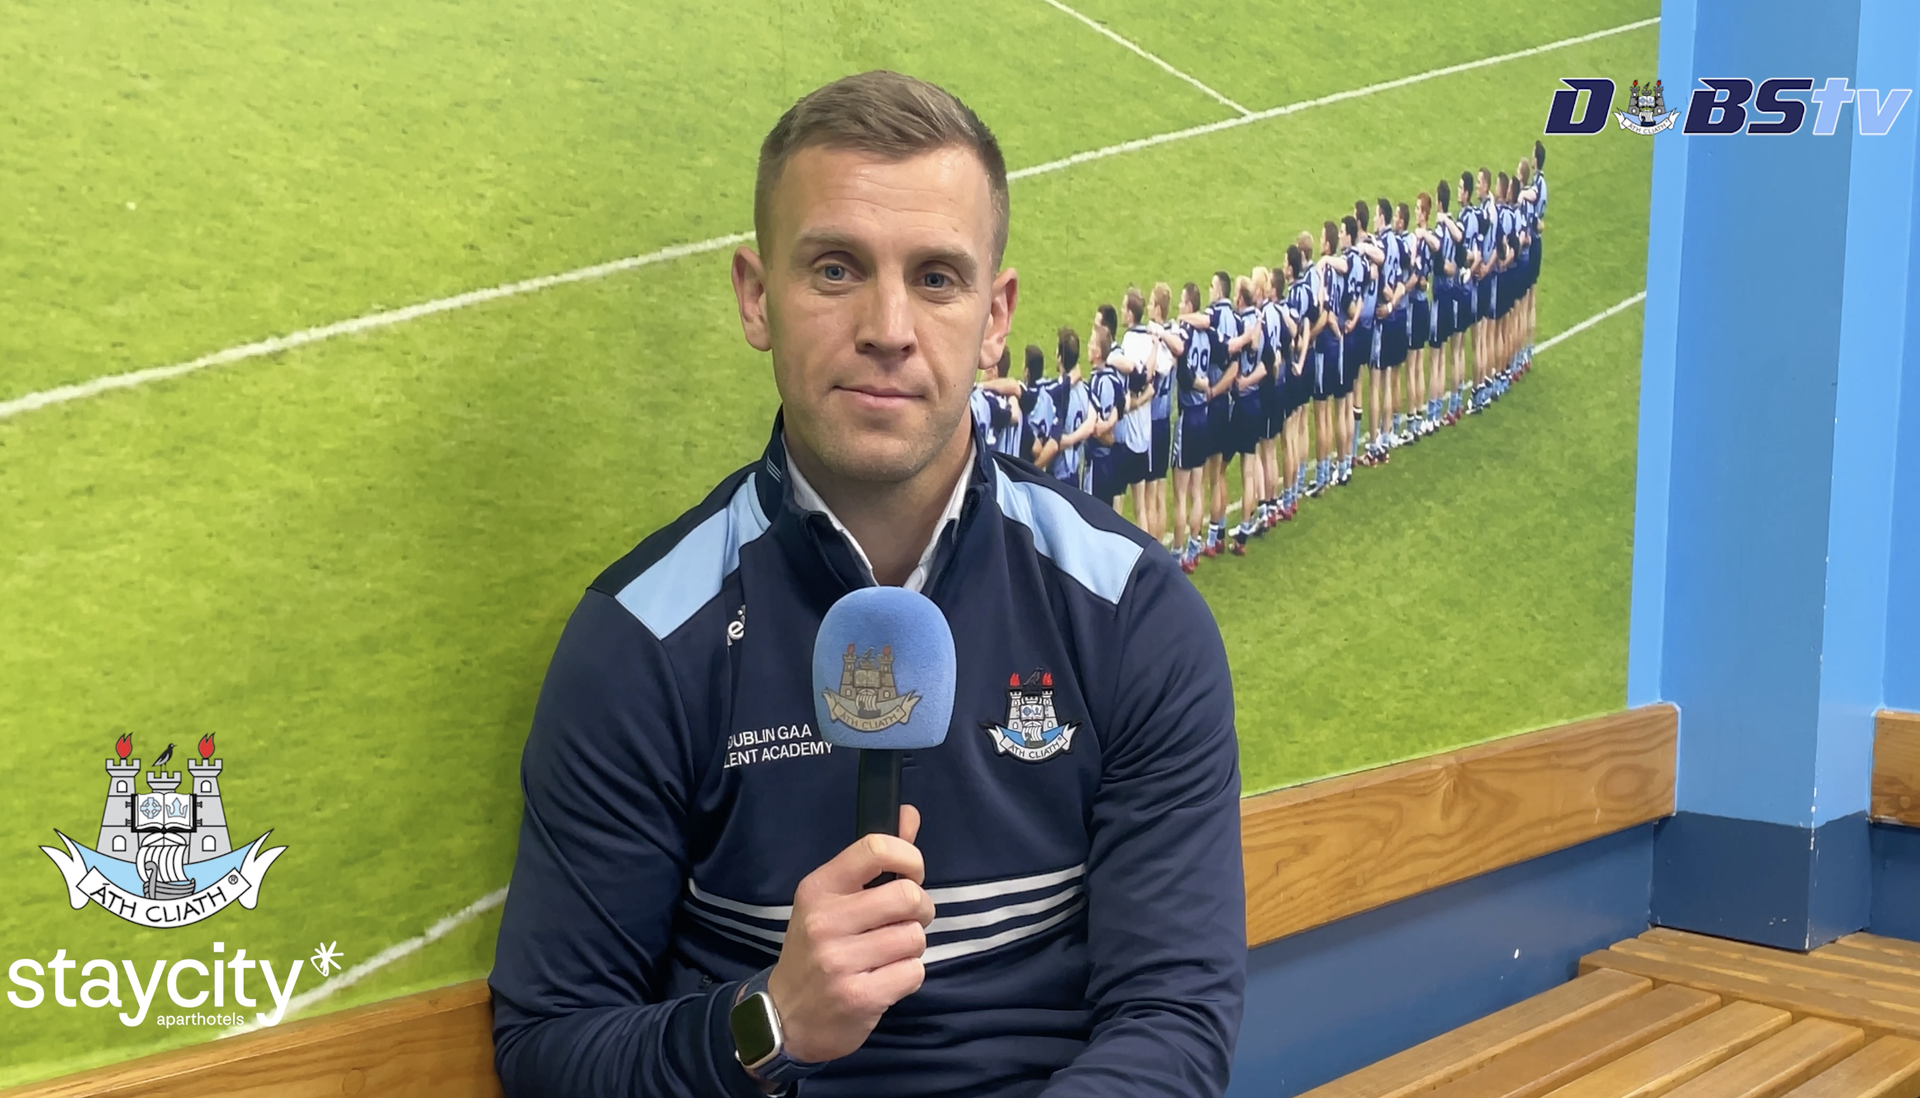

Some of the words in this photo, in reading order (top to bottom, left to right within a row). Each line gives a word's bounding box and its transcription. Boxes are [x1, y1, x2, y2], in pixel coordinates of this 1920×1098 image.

[862, 713, 897, 730] CLIATH
[777, 723, 812, 740] GAA
[761, 741, 832, 762] ACADEMY
[1028, 741, 1060, 759] CLIATH
